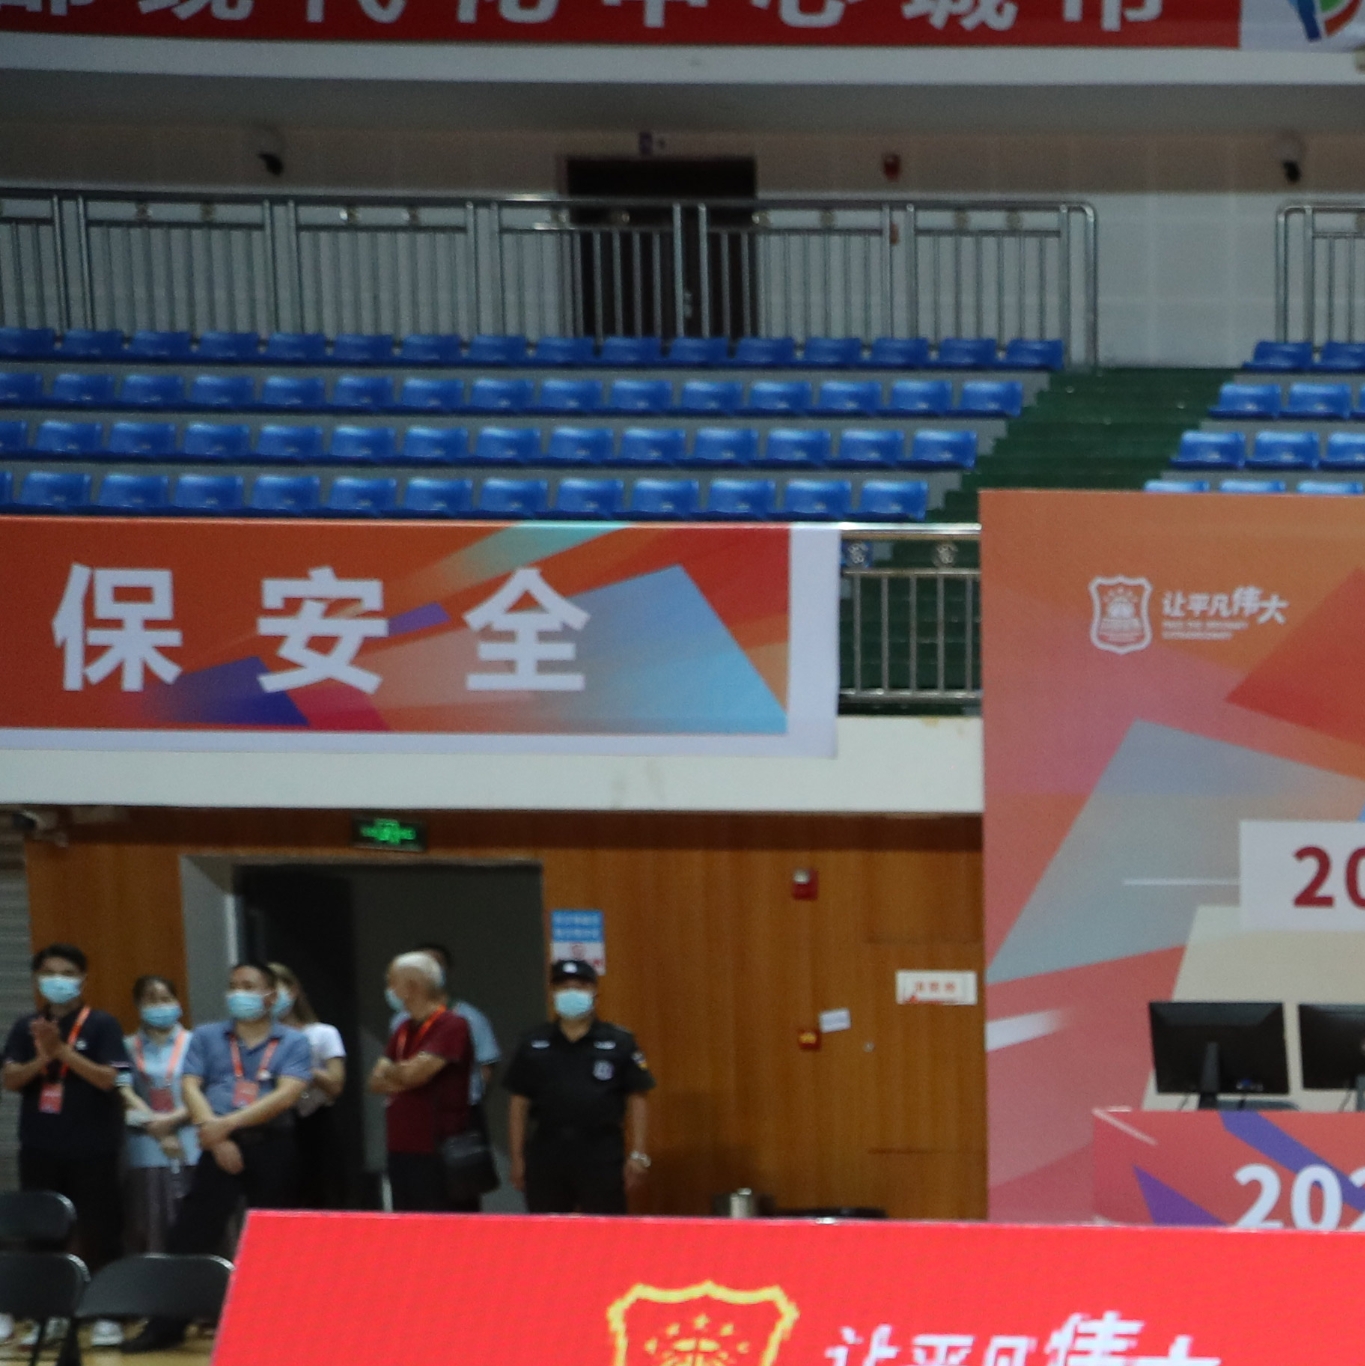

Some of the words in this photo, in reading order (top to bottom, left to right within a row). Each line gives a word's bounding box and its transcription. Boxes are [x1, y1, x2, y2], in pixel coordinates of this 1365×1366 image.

[51, 563, 590, 693] 保安全
[1162, 585, 1289, 624] 让平凡伟大
